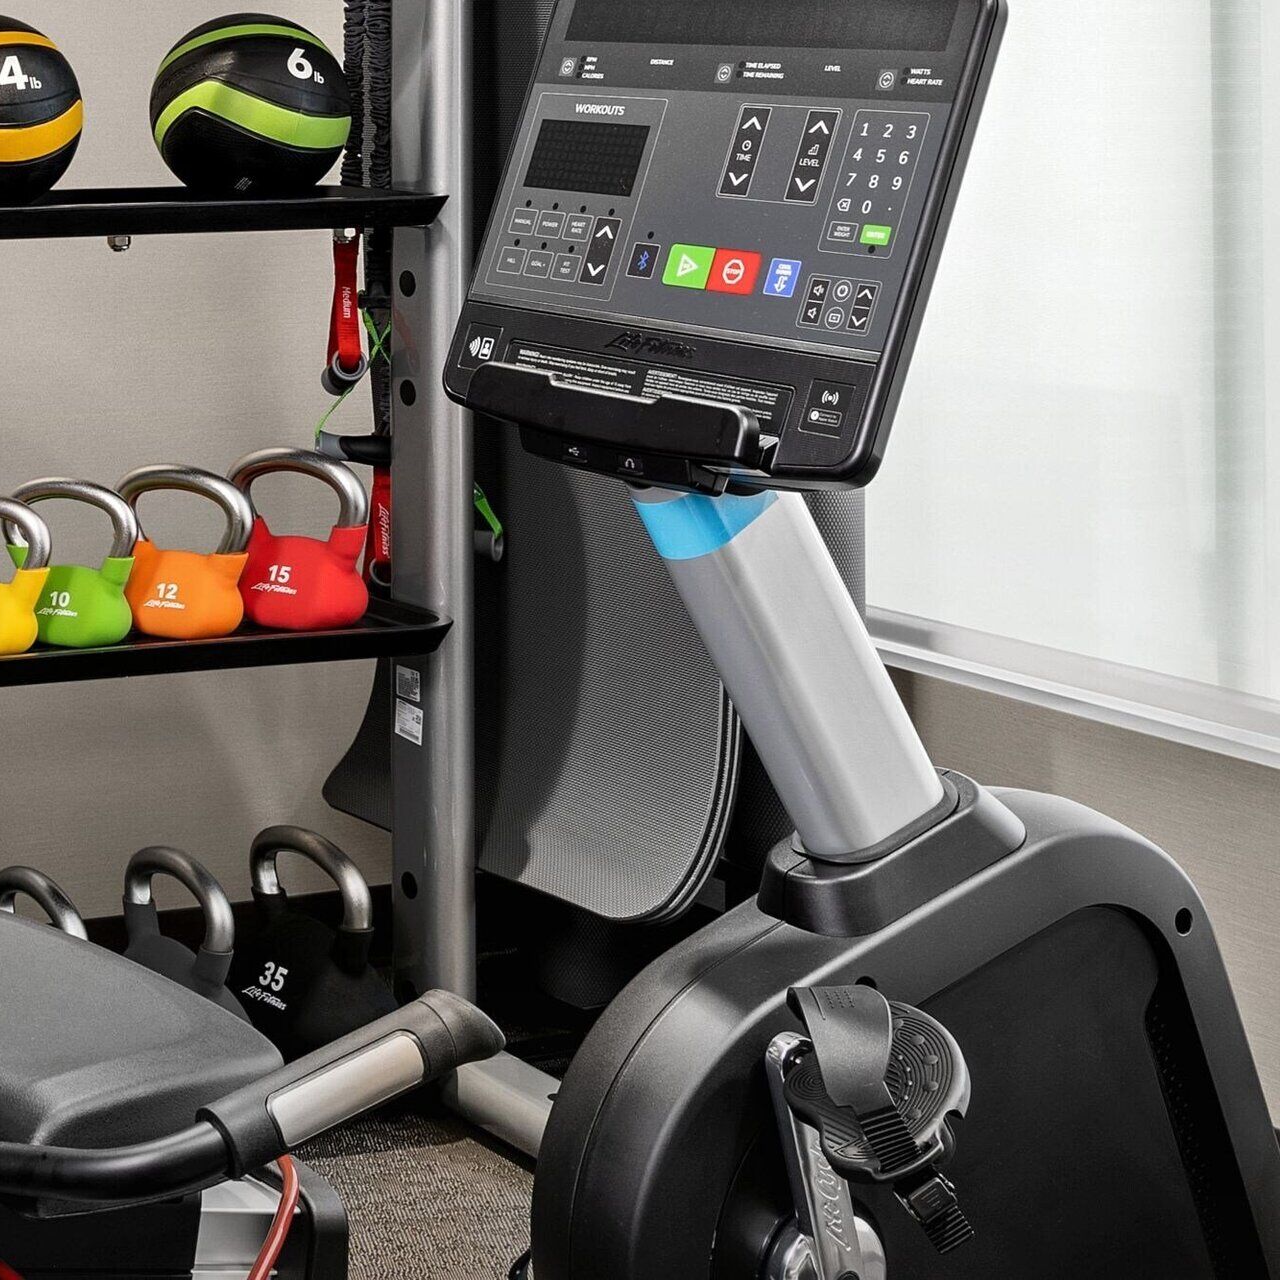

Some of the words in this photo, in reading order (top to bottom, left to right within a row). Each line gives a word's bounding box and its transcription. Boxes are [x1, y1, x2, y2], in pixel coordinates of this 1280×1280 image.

[286, 48, 313, 79] 6
[313, 69, 324, 84] lb
[29, 77, 42, 90] lb
[575, 103, 626, 115] WORKOUTS
[860, 122, 869, 137] 1
[882, 123, 894, 138] 2
[906, 125, 917, 139] 3
[736, 153, 752, 162] TIME
[799, 158, 820, 167] LEVEL
[853, 148, 863, 162] 4
[876, 149, 886, 163] 5
[898, 150, 909, 165] 6
[846, 173, 857, 187] 7
[868, 174, 879, 188] 8
[891, 176, 902, 190] 9
[861, 200, 872, 214] 0
[342, 286, 352, 318] Medium
[268, 564, 291, 583] 15
[50, 591, 70, 607] 10
[156, 582, 179, 600] 12
[259, 961, 288, 991] 35
